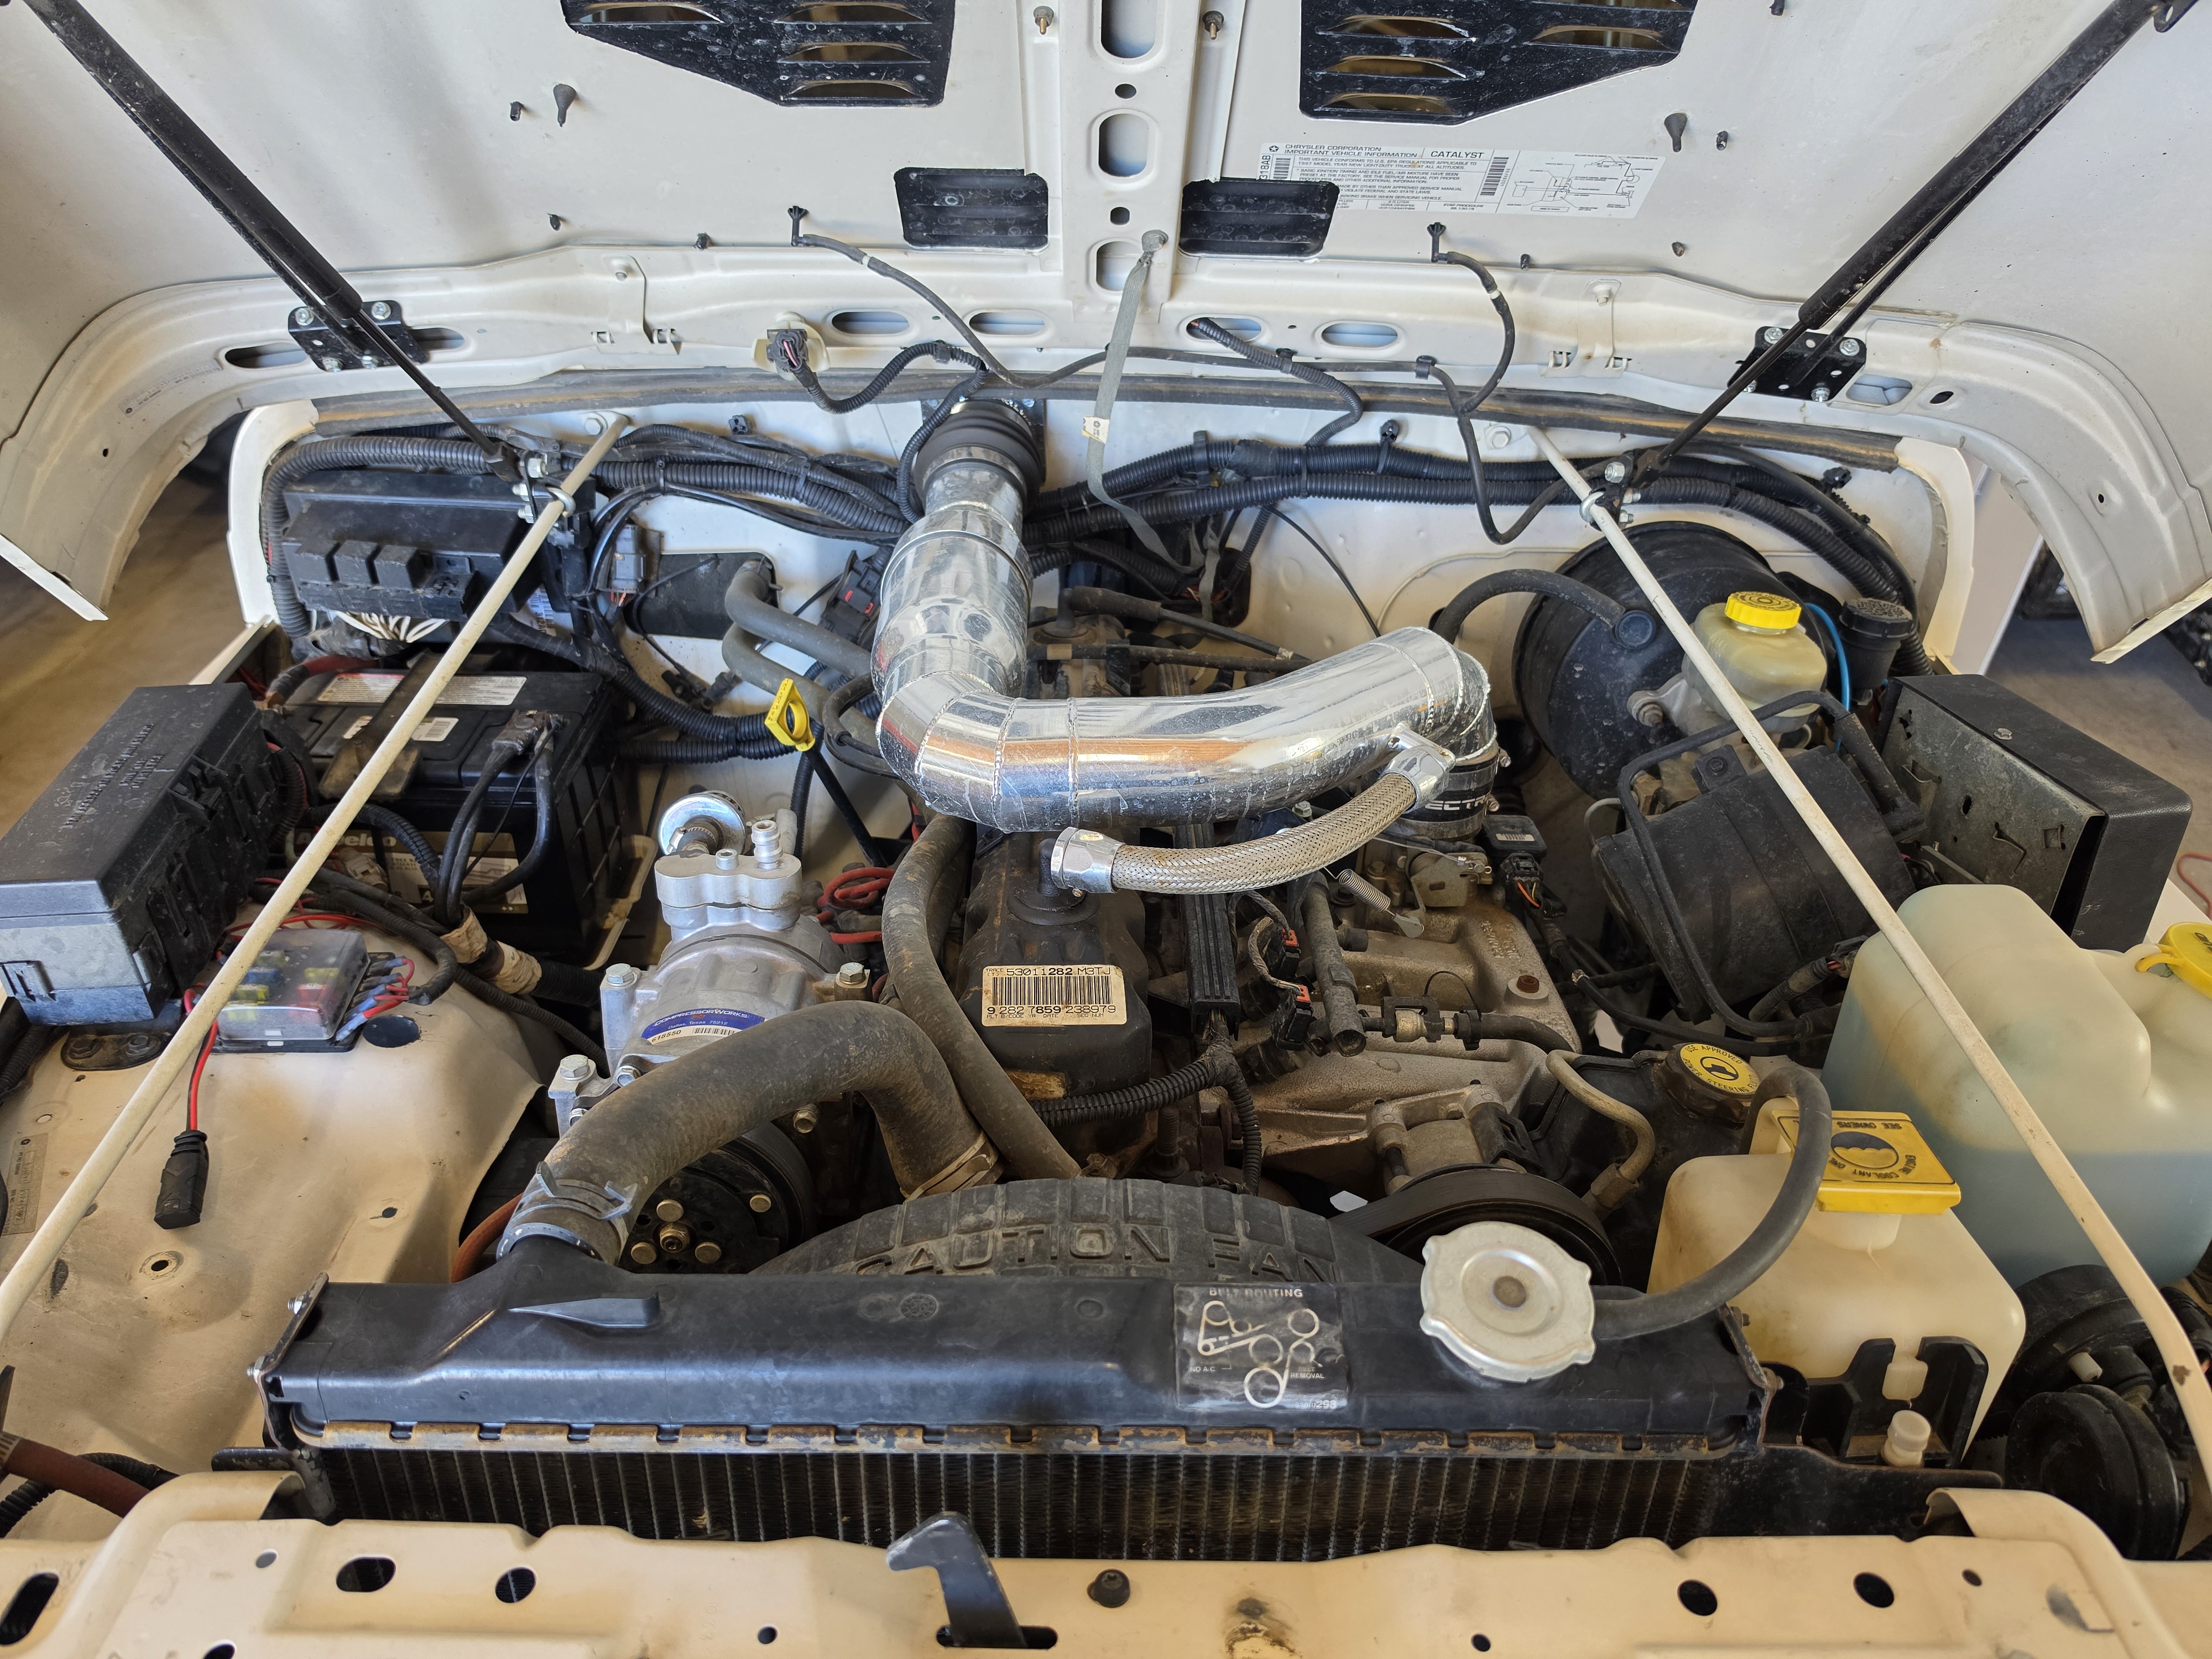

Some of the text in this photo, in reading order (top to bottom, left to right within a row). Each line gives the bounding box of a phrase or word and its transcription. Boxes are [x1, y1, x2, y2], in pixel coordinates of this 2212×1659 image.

[1077, 967, 1111, 975] M3TJ
[987, 1005, 1117, 1015] 9 282 7859 238979
[651, 1029, 681, 1043] 618550
[1684, 1045, 1742, 1065] USE APPROVED
[1683, 1058, 1757, 1093] POWER STEERING FLUID
[1828, 1154, 1917, 1179] ENGINE COOLANT ONL
[1207, 1235, 1337, 1283] FAN
